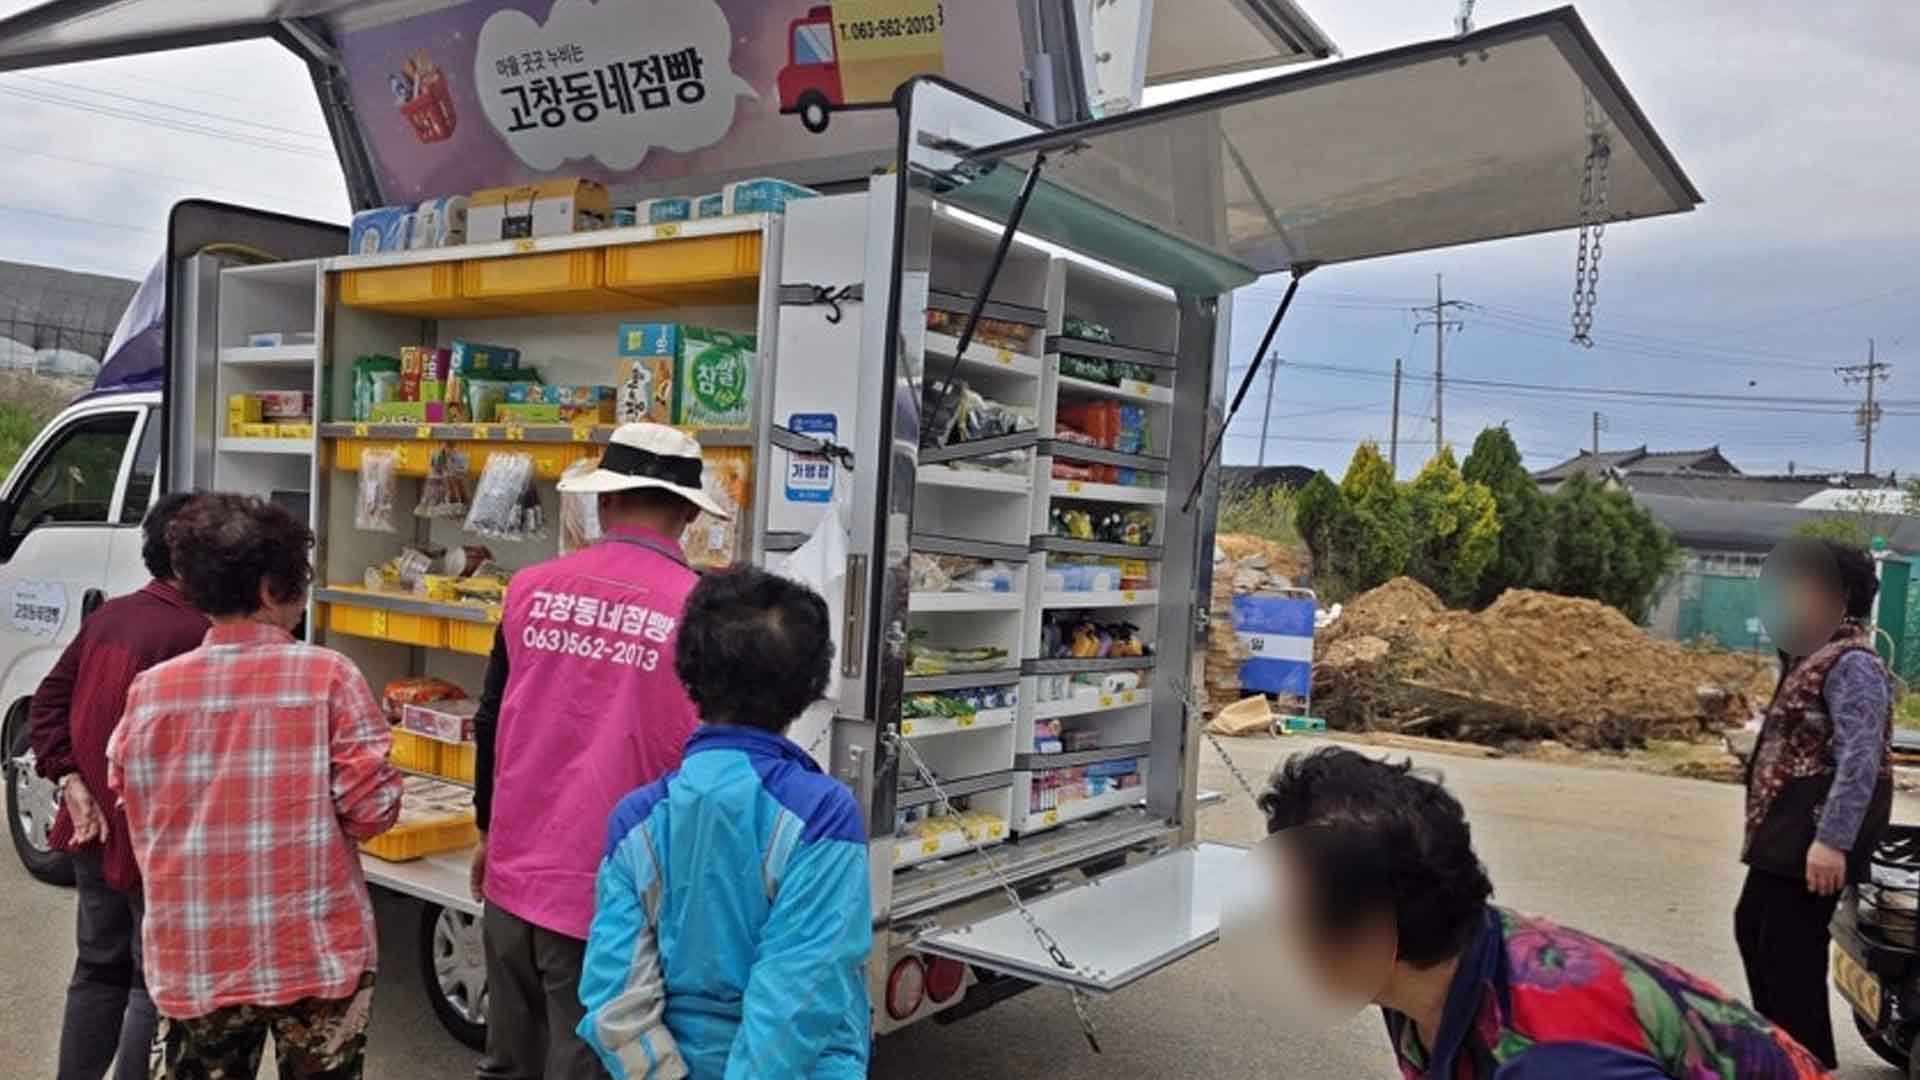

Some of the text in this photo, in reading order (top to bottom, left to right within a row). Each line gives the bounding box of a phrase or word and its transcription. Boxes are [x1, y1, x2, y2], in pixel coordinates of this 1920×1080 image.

[500, 47, 706, 132] 고창동네점빵
[529, 591, 675, 643] 고창동네점빵
[523, 626, 660, 671] 063)562-2013
